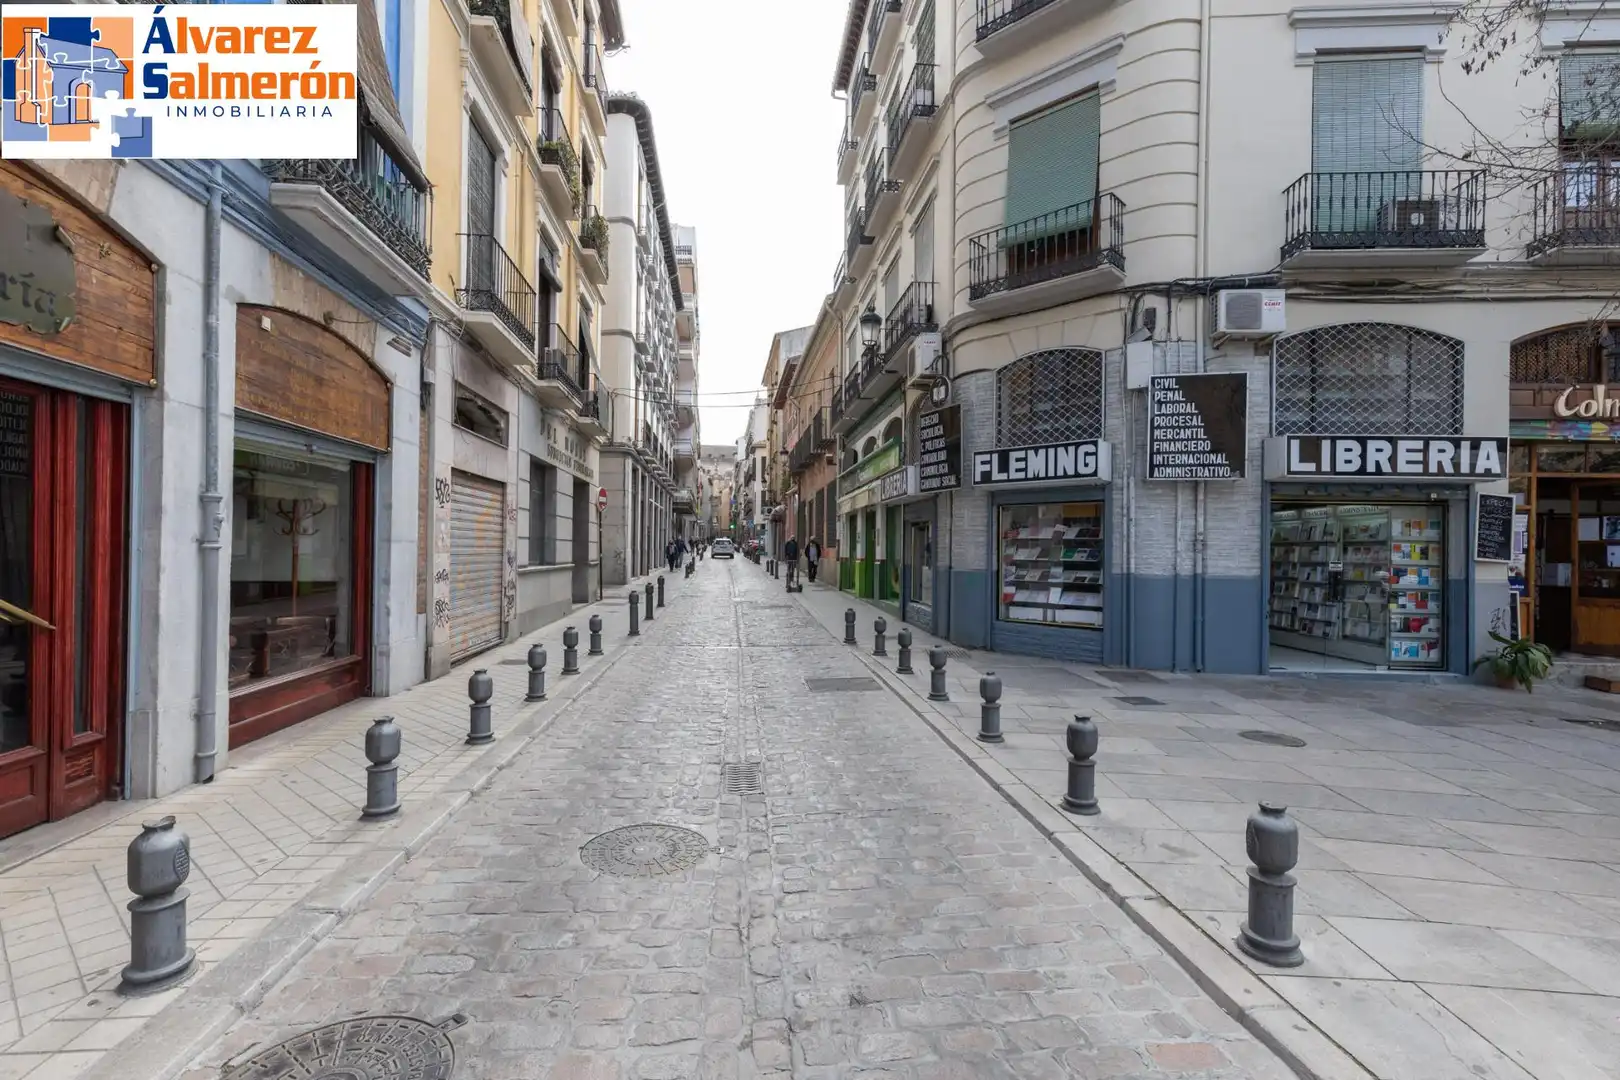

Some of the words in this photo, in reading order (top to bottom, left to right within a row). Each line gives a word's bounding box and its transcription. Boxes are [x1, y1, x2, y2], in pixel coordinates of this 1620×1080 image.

[1154, 378, 1180, 389] CIVIL
[1154, 390, 1186, 402] PENAL
[1154, 402, 1199, 415] LABORAL
[1154, 415, 1205, 427] PROCESAL
[1153, 428, 1208, 440] MERCANTIL
[1153, 440, 1211, 453] FINANCIERO
[1153, 453, 1229, 465] INTERNACIONAL
[1290, 439, 1501, 474] LIBRERIA
[974, 444, 1097, 482] FLEMING
[1153, 466, 1231, 478] ADMINISTRATIVO
